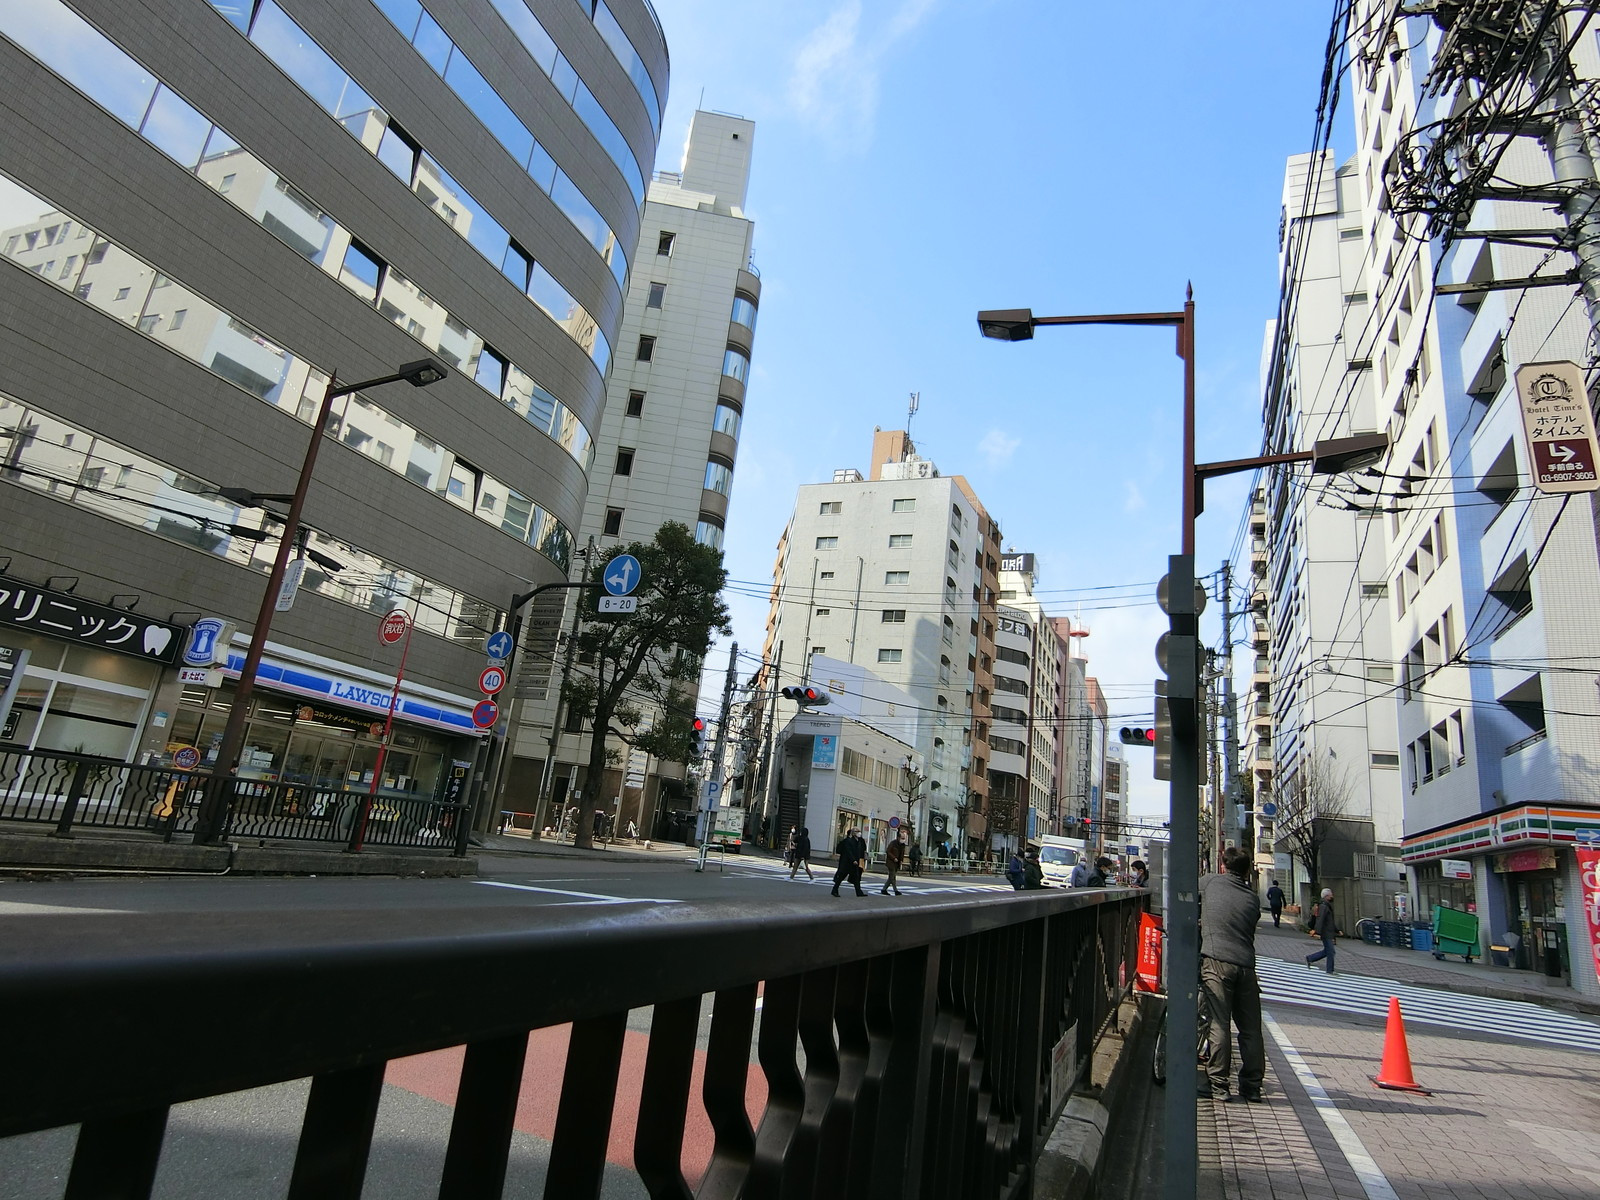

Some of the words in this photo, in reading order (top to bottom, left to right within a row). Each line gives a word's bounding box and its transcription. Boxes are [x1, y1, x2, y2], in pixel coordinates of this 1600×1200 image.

[1536, 415, 1576, 425] ホテル
[1532, 424, 1586, 438] タイムズ
[1548, 462, 1583, 472] 手前曲る
[604, 599, 632, 610] 8-20
[384, 622, 405, 634] 消火栓
[485, 675, 500, 688] 40
[333, 683, 402, 711] LAWSON
[708, 782, 719, 796] P
